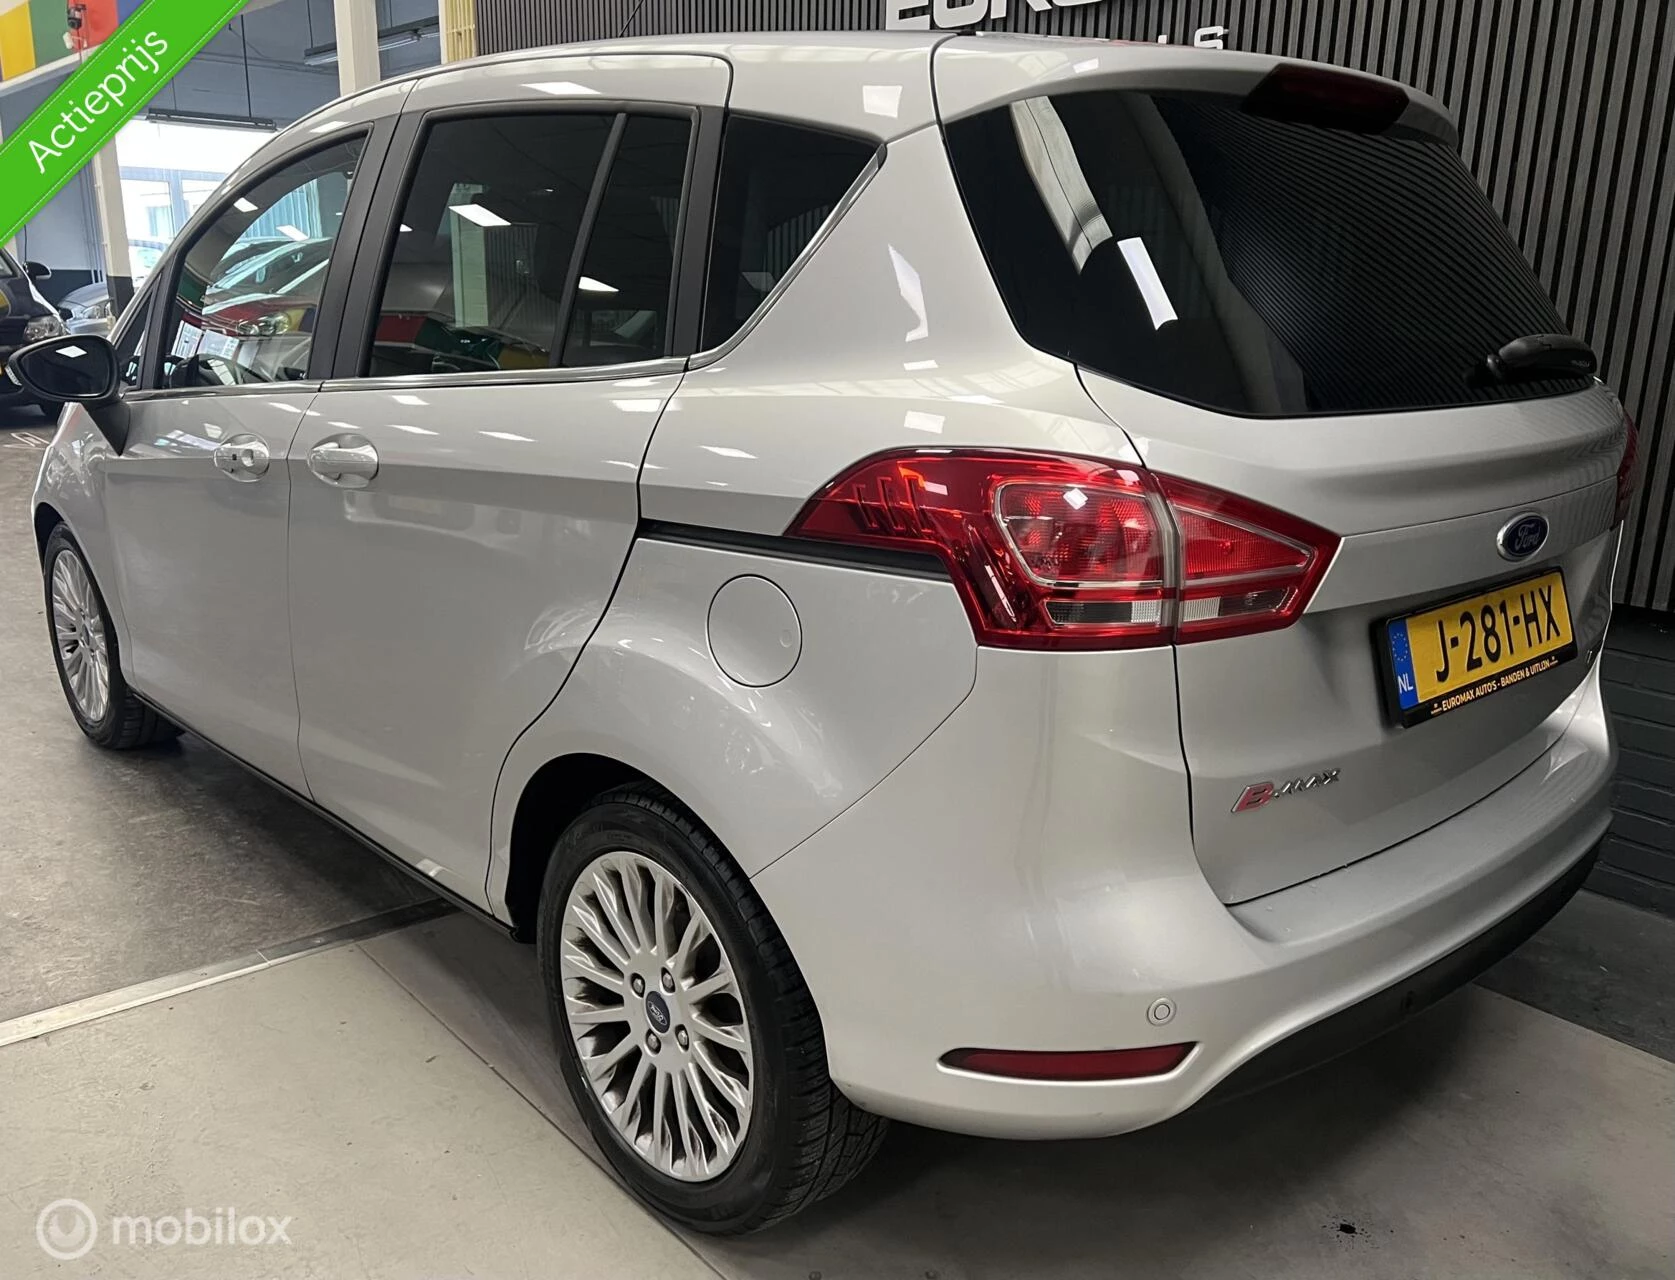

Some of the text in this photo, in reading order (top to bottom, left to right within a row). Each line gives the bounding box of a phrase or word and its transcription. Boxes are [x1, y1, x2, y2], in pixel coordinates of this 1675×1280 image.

[1436, 585, 1560, 682] J-281-HX
[1398, 674, 1413, 694] NL
[1442, 690, 1475, 711] EUROMAX
[1500, 670, 1525, 687] BANDEN
